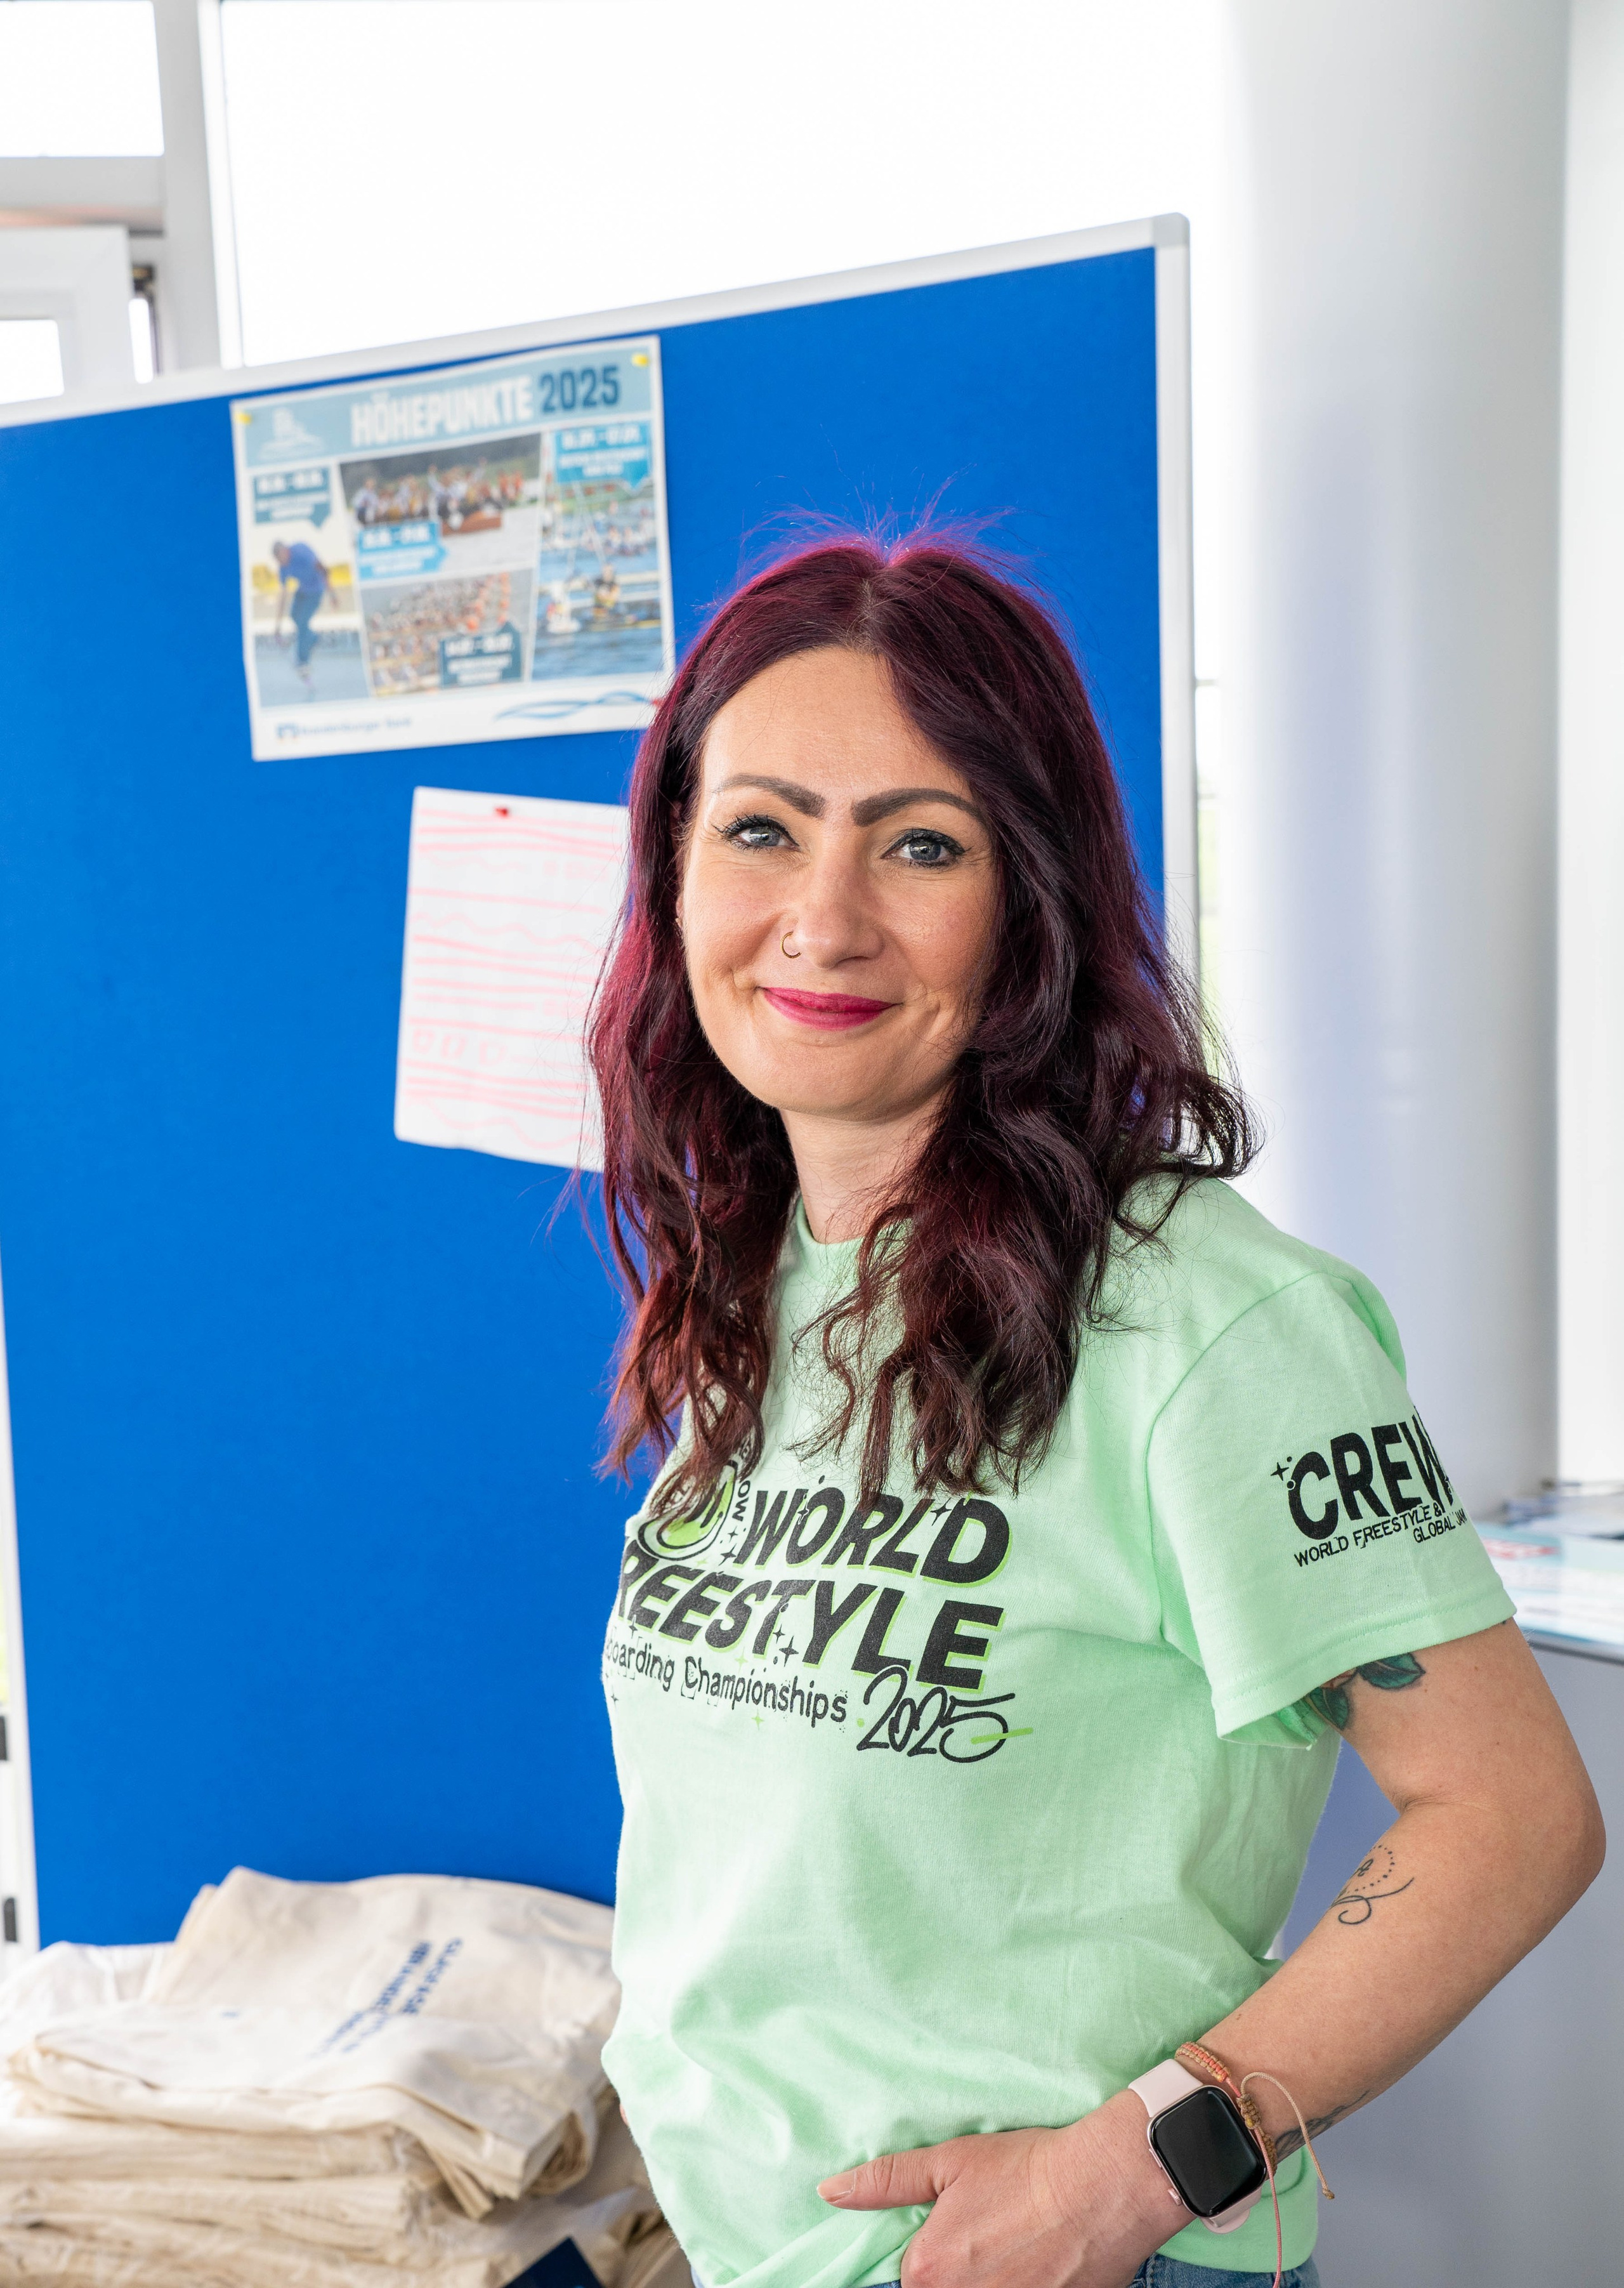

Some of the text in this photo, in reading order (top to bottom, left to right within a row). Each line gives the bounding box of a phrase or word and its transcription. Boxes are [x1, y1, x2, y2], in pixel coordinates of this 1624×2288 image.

[351, 374, 533, 447] HÖHEPUNKTE
[539, 365, 620, 413] 2025
[1288, 1405, 1454, 1540] CREW
[732, 1485, 1011, 1586] WORLD
[1293, 1502, 1442, 1567] WORLD FREESTYLE &
[1413, 1516, 1456, 1543] GLOBAL
[617, 1535, 1005, 1690] REESTYLE
[684, 1655, 849, 1727] Championships
[856, 1666, 1015, 1764] 2025
